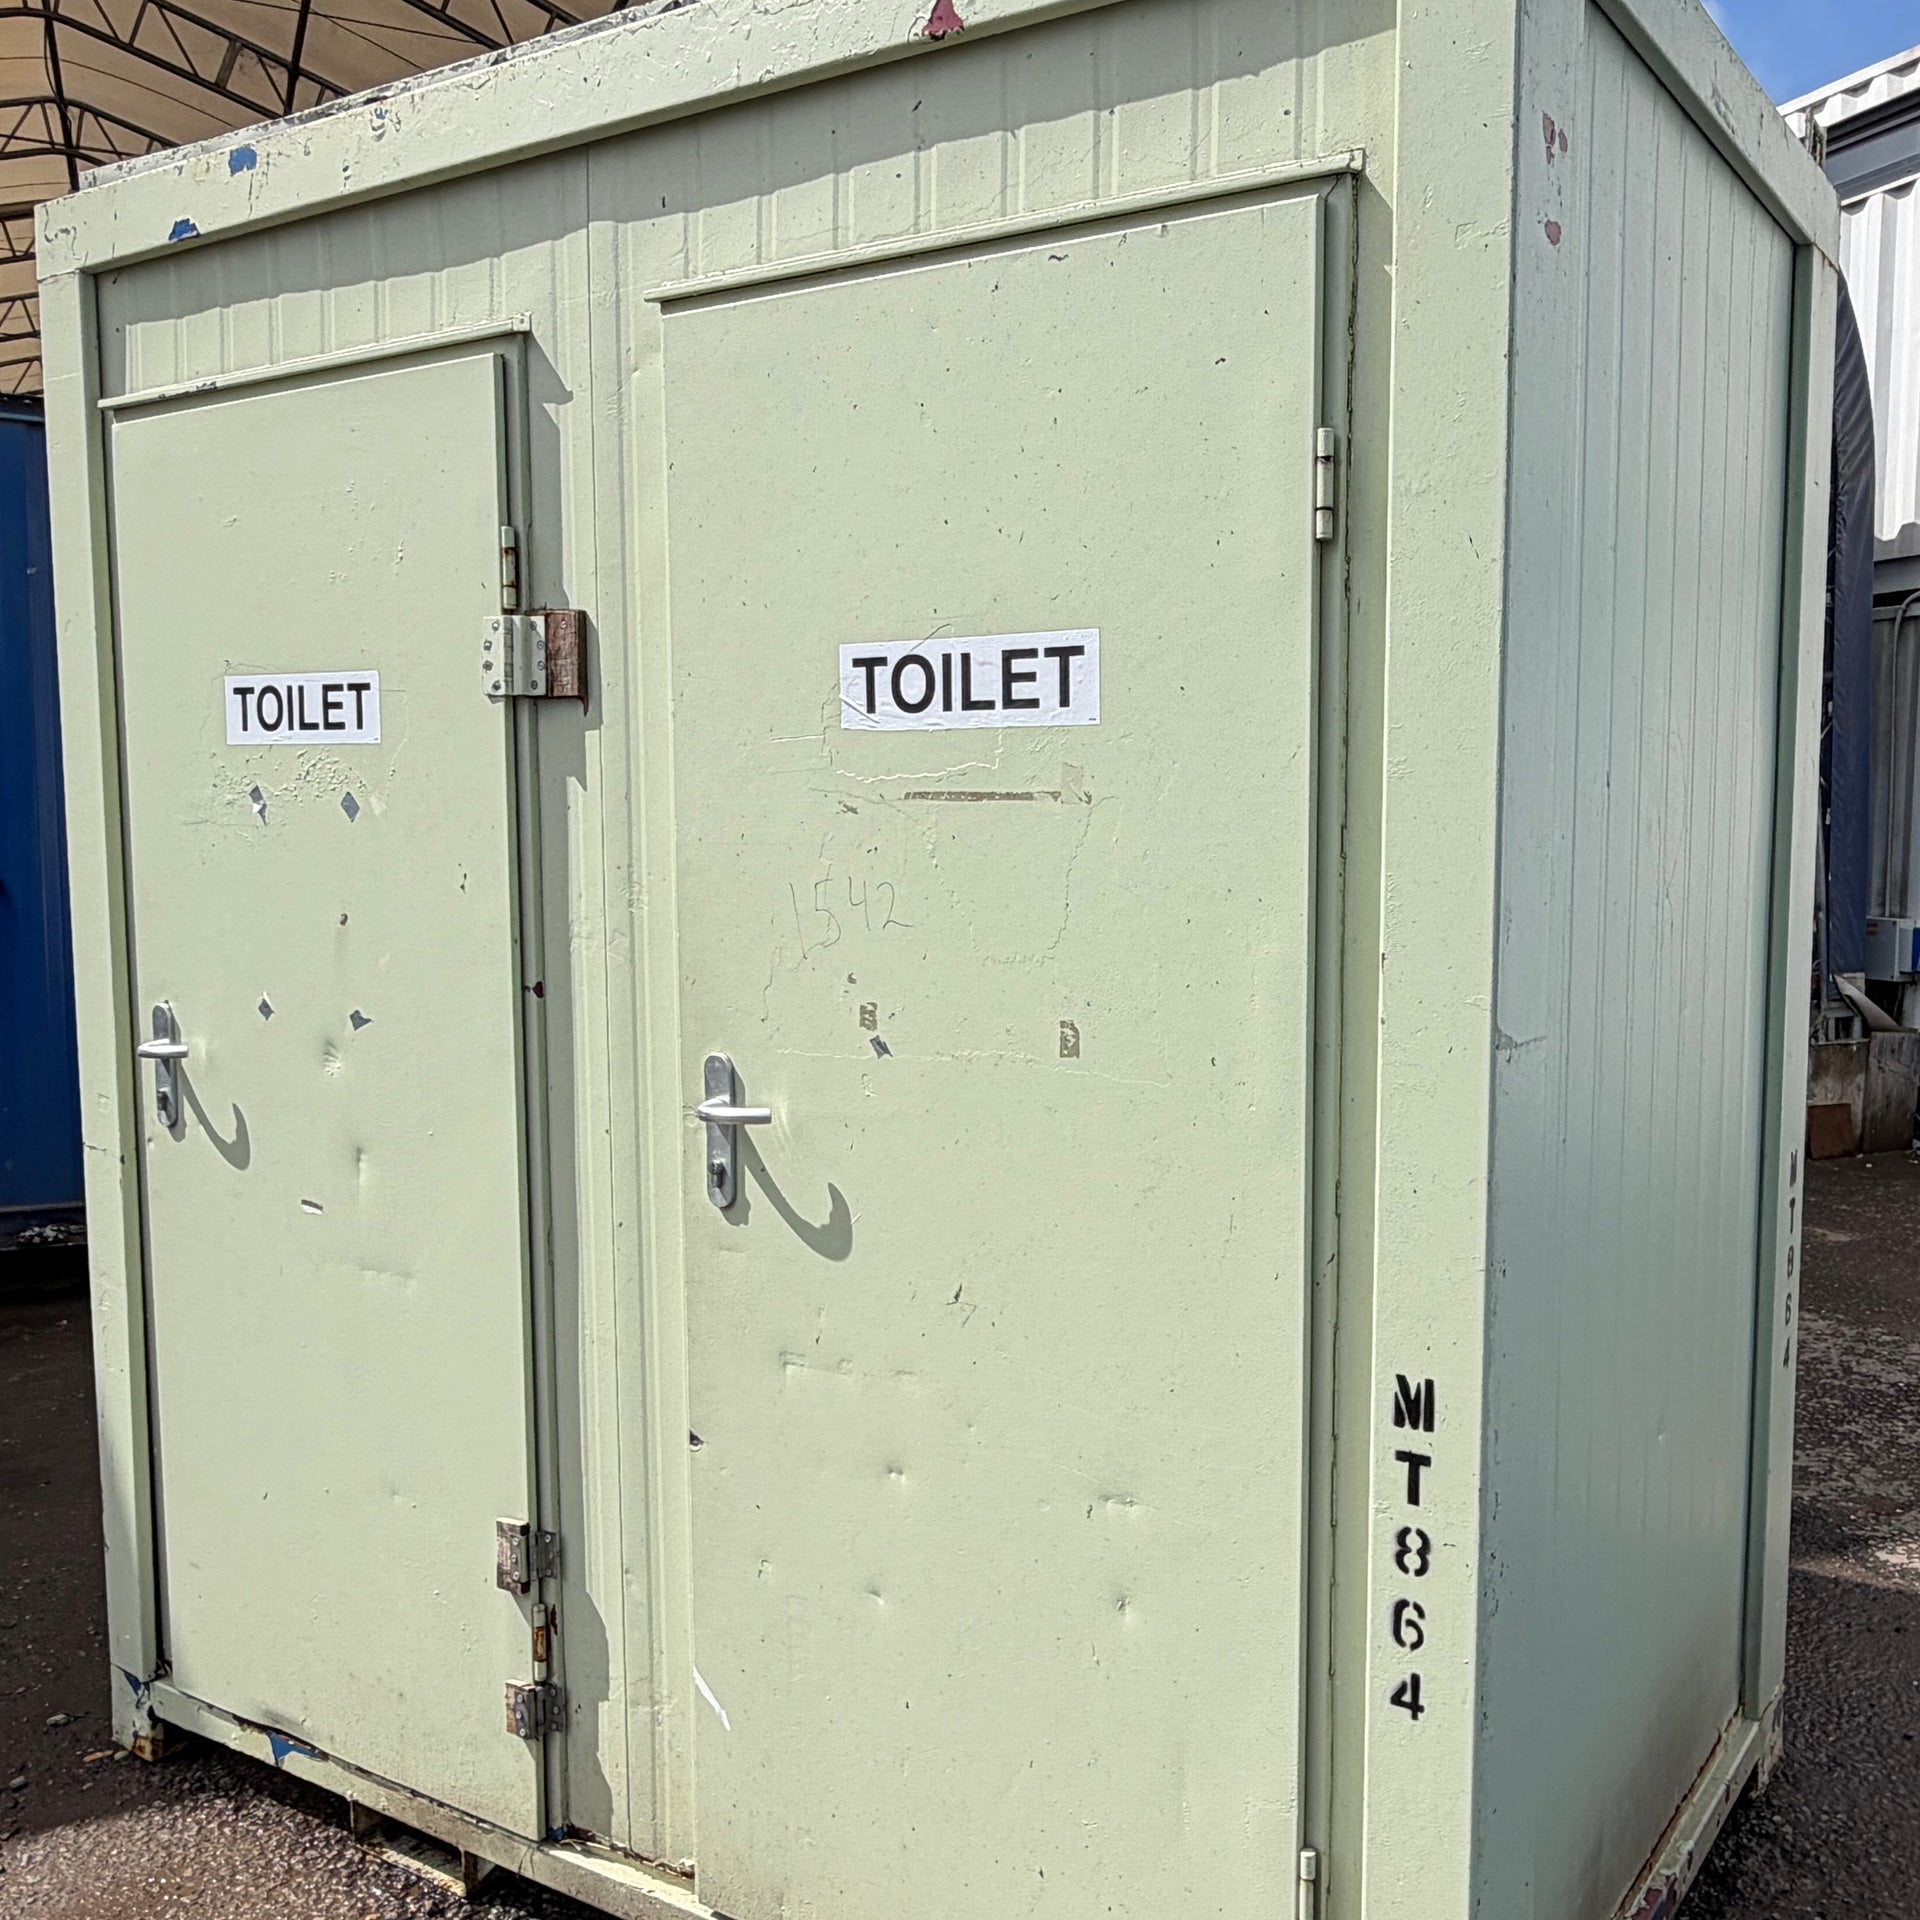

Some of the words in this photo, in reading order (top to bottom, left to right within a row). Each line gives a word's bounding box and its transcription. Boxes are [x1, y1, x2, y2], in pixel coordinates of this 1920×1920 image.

[233, 682, 371, 732] TOILET
[852, 645, 1085, 714] TOILET
[789, 876, 914, 959] 1542
